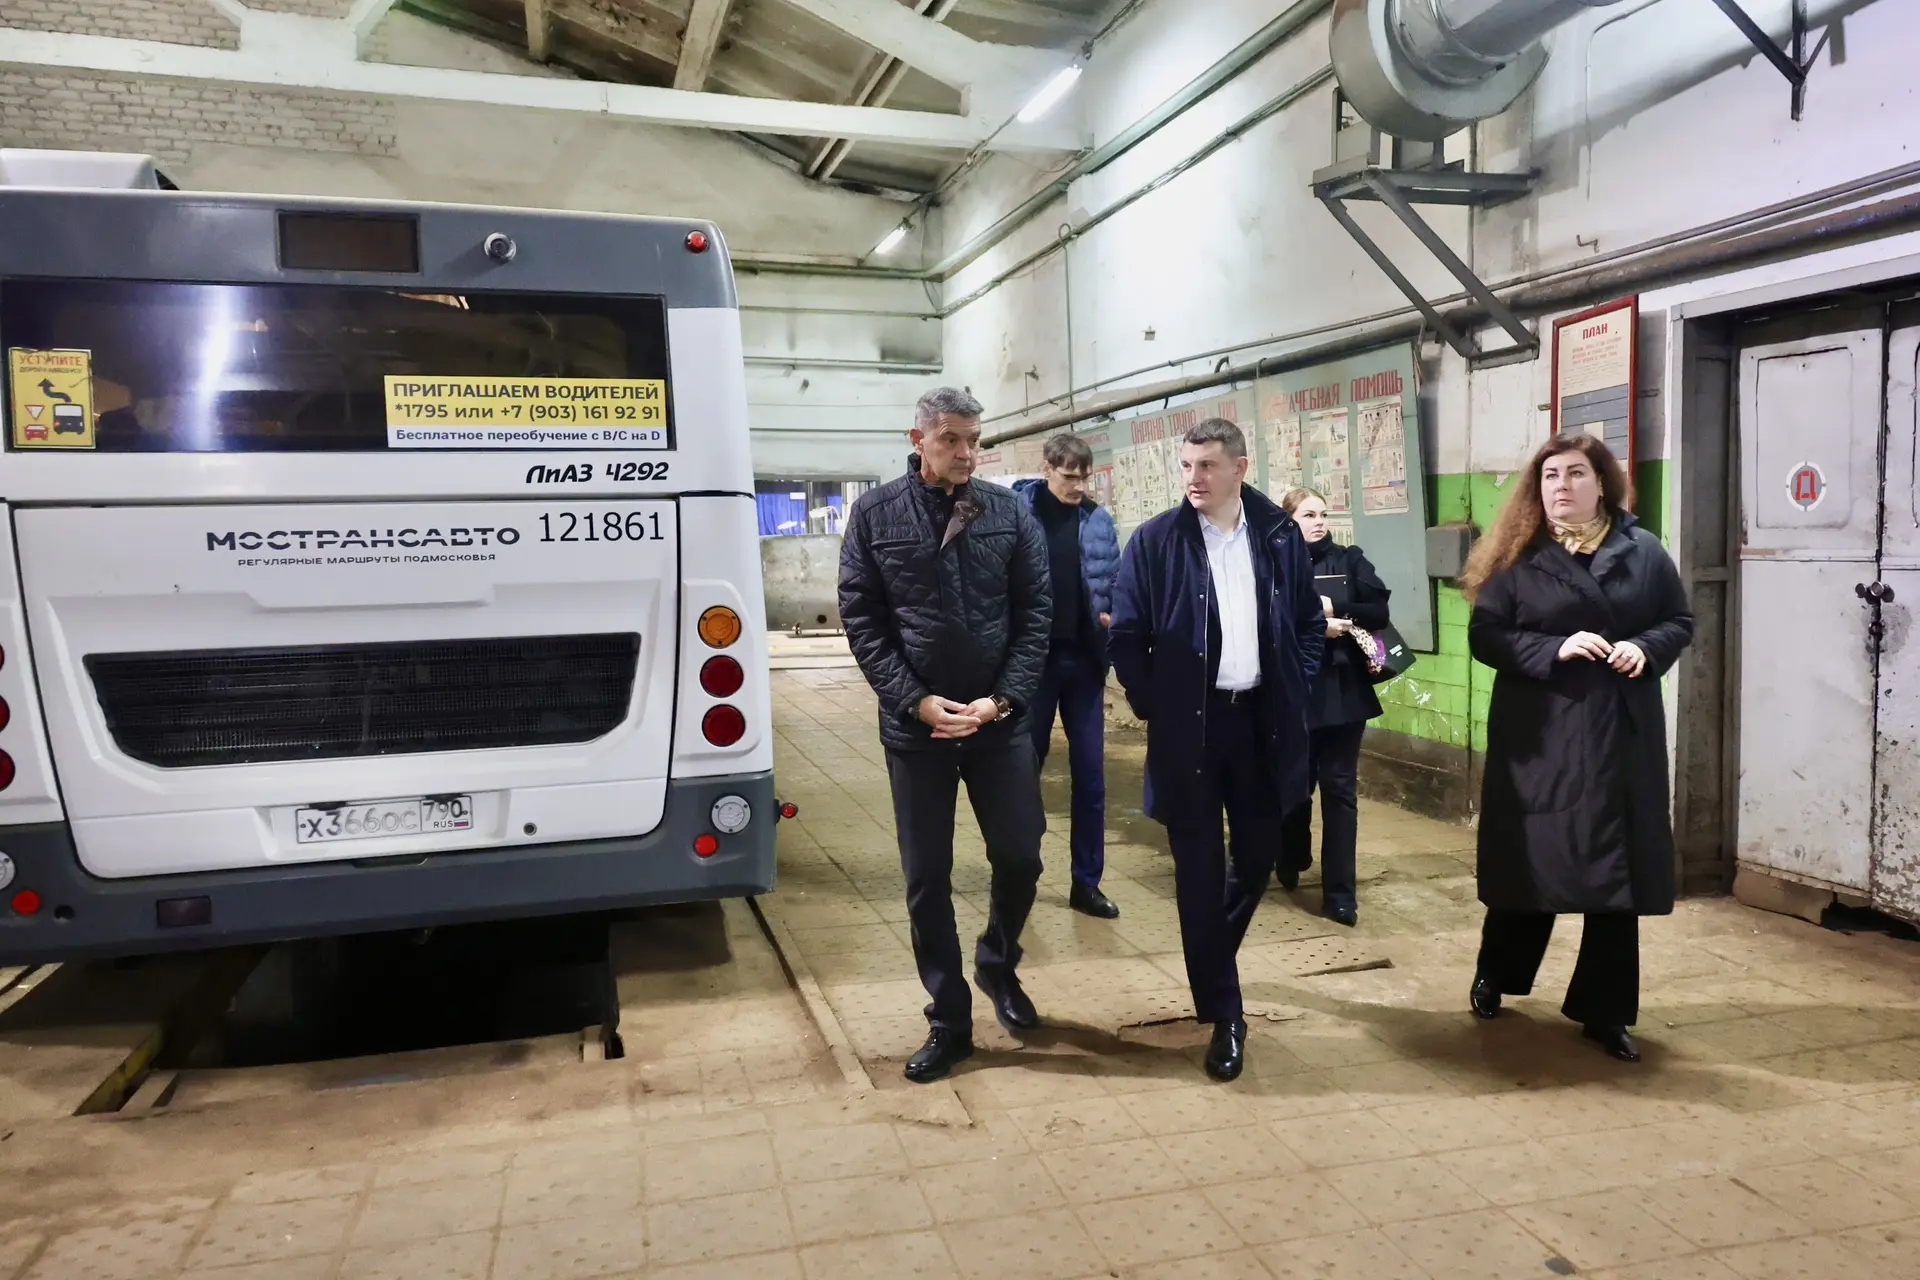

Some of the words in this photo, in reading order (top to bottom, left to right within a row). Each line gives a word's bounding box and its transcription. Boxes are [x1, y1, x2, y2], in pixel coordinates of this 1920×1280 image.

[1582, 323, 1608, 340] ПЛАН
[393, 383, 540, 399] ПРИГЛАШАЕМ
[545, 383, 659, 401] ВОДИТЕЛЕЙ
[1287, 383, 1341, 413] АЧЕБНАЯ
[1351, 369, 1404, 403] ПОМОЩЬ
[455, 407, 494, 418] или
[500, 405, 523, 418] +7
[529, 404, 577, 422] (903)
[582, 405, 609, 419] 161
[614, 406, 637, 419] 92
[641, 406, 660, 420] 91
[396, 429, 484, 441] Бесплатное
[488, 430, 588, 442] переобучение
[631, 433, 648, 441] на
[651, 430, 661, 441] D
[605, 462, 670, 482] 4292
[538, 511, 665, 543] 121861
[206, 527, 521, 552] МОСТРАНСАВТО
[238, 557, 323, 567] РЕГУЛЯРНЫЕ
[326, 555, 401, 565] МАРШРУТЫ
[404, 553, 496, 563] ПОДМОСКОВЬЯ
[423, 800, 463, 822] 790
[433, 820, 454, 829] RUS
